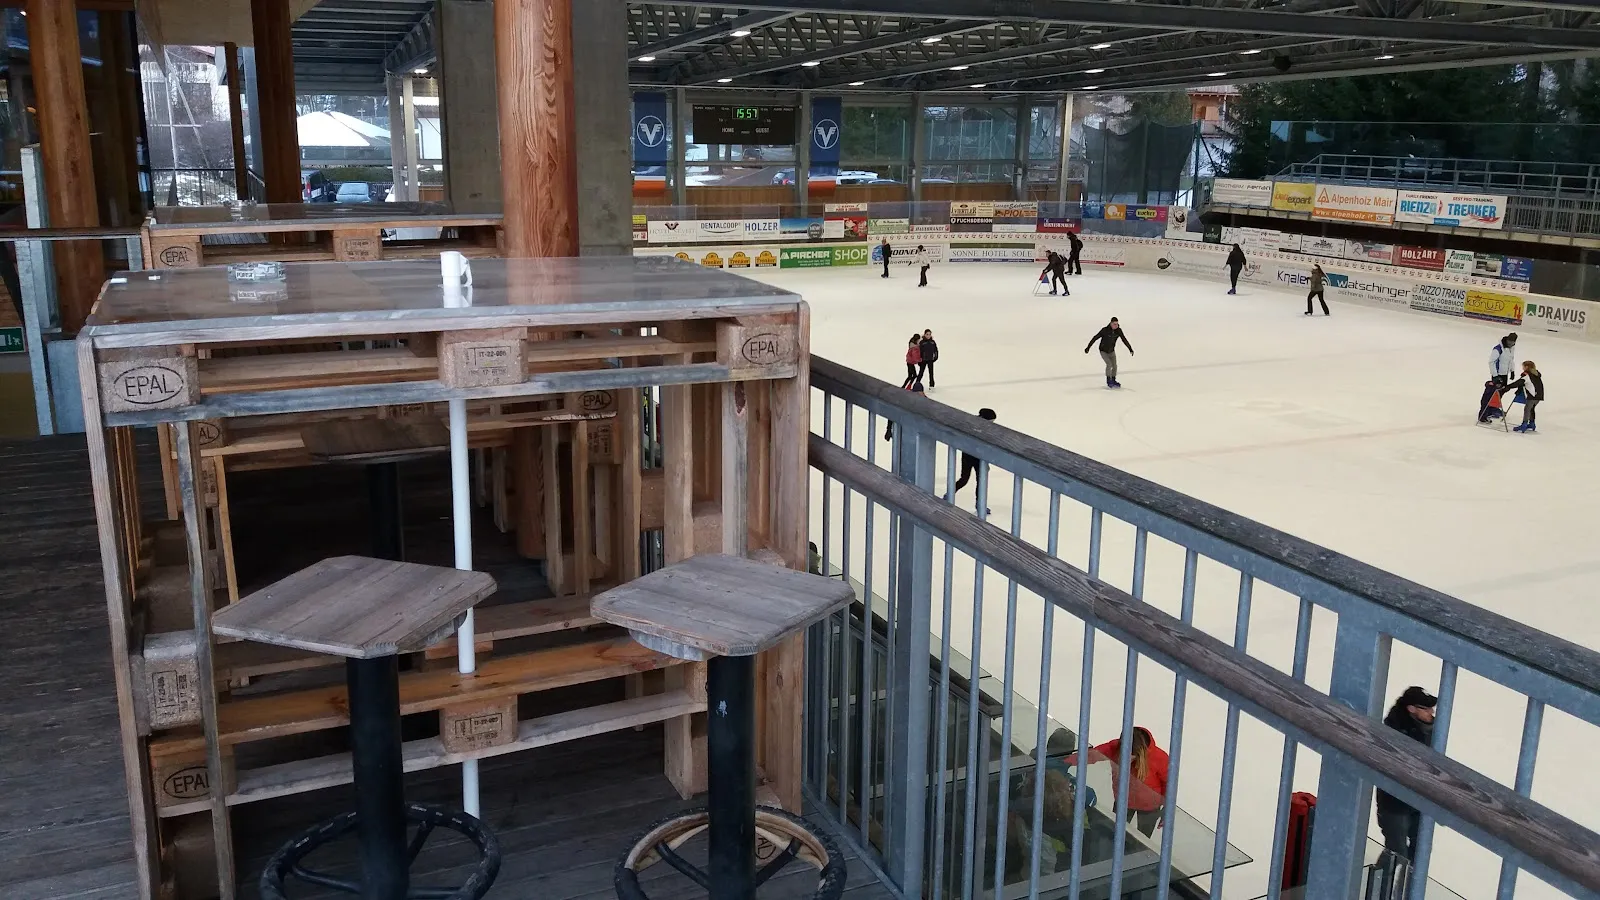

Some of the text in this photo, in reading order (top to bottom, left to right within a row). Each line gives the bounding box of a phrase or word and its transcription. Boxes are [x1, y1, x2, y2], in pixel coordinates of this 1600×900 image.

[1332, 194, 1393, 208] Alpenholz Mair
[1448, 203, 1497, 218] TRENKER
[744, 222, 778, 232] HOLZER
[166, 250, 190, 262] EPAL
[834, 248, 868, 260] SHOP
[1538, 306, 1586, 324] DRAVUS
[124, 374, 175, 396] EPAL
